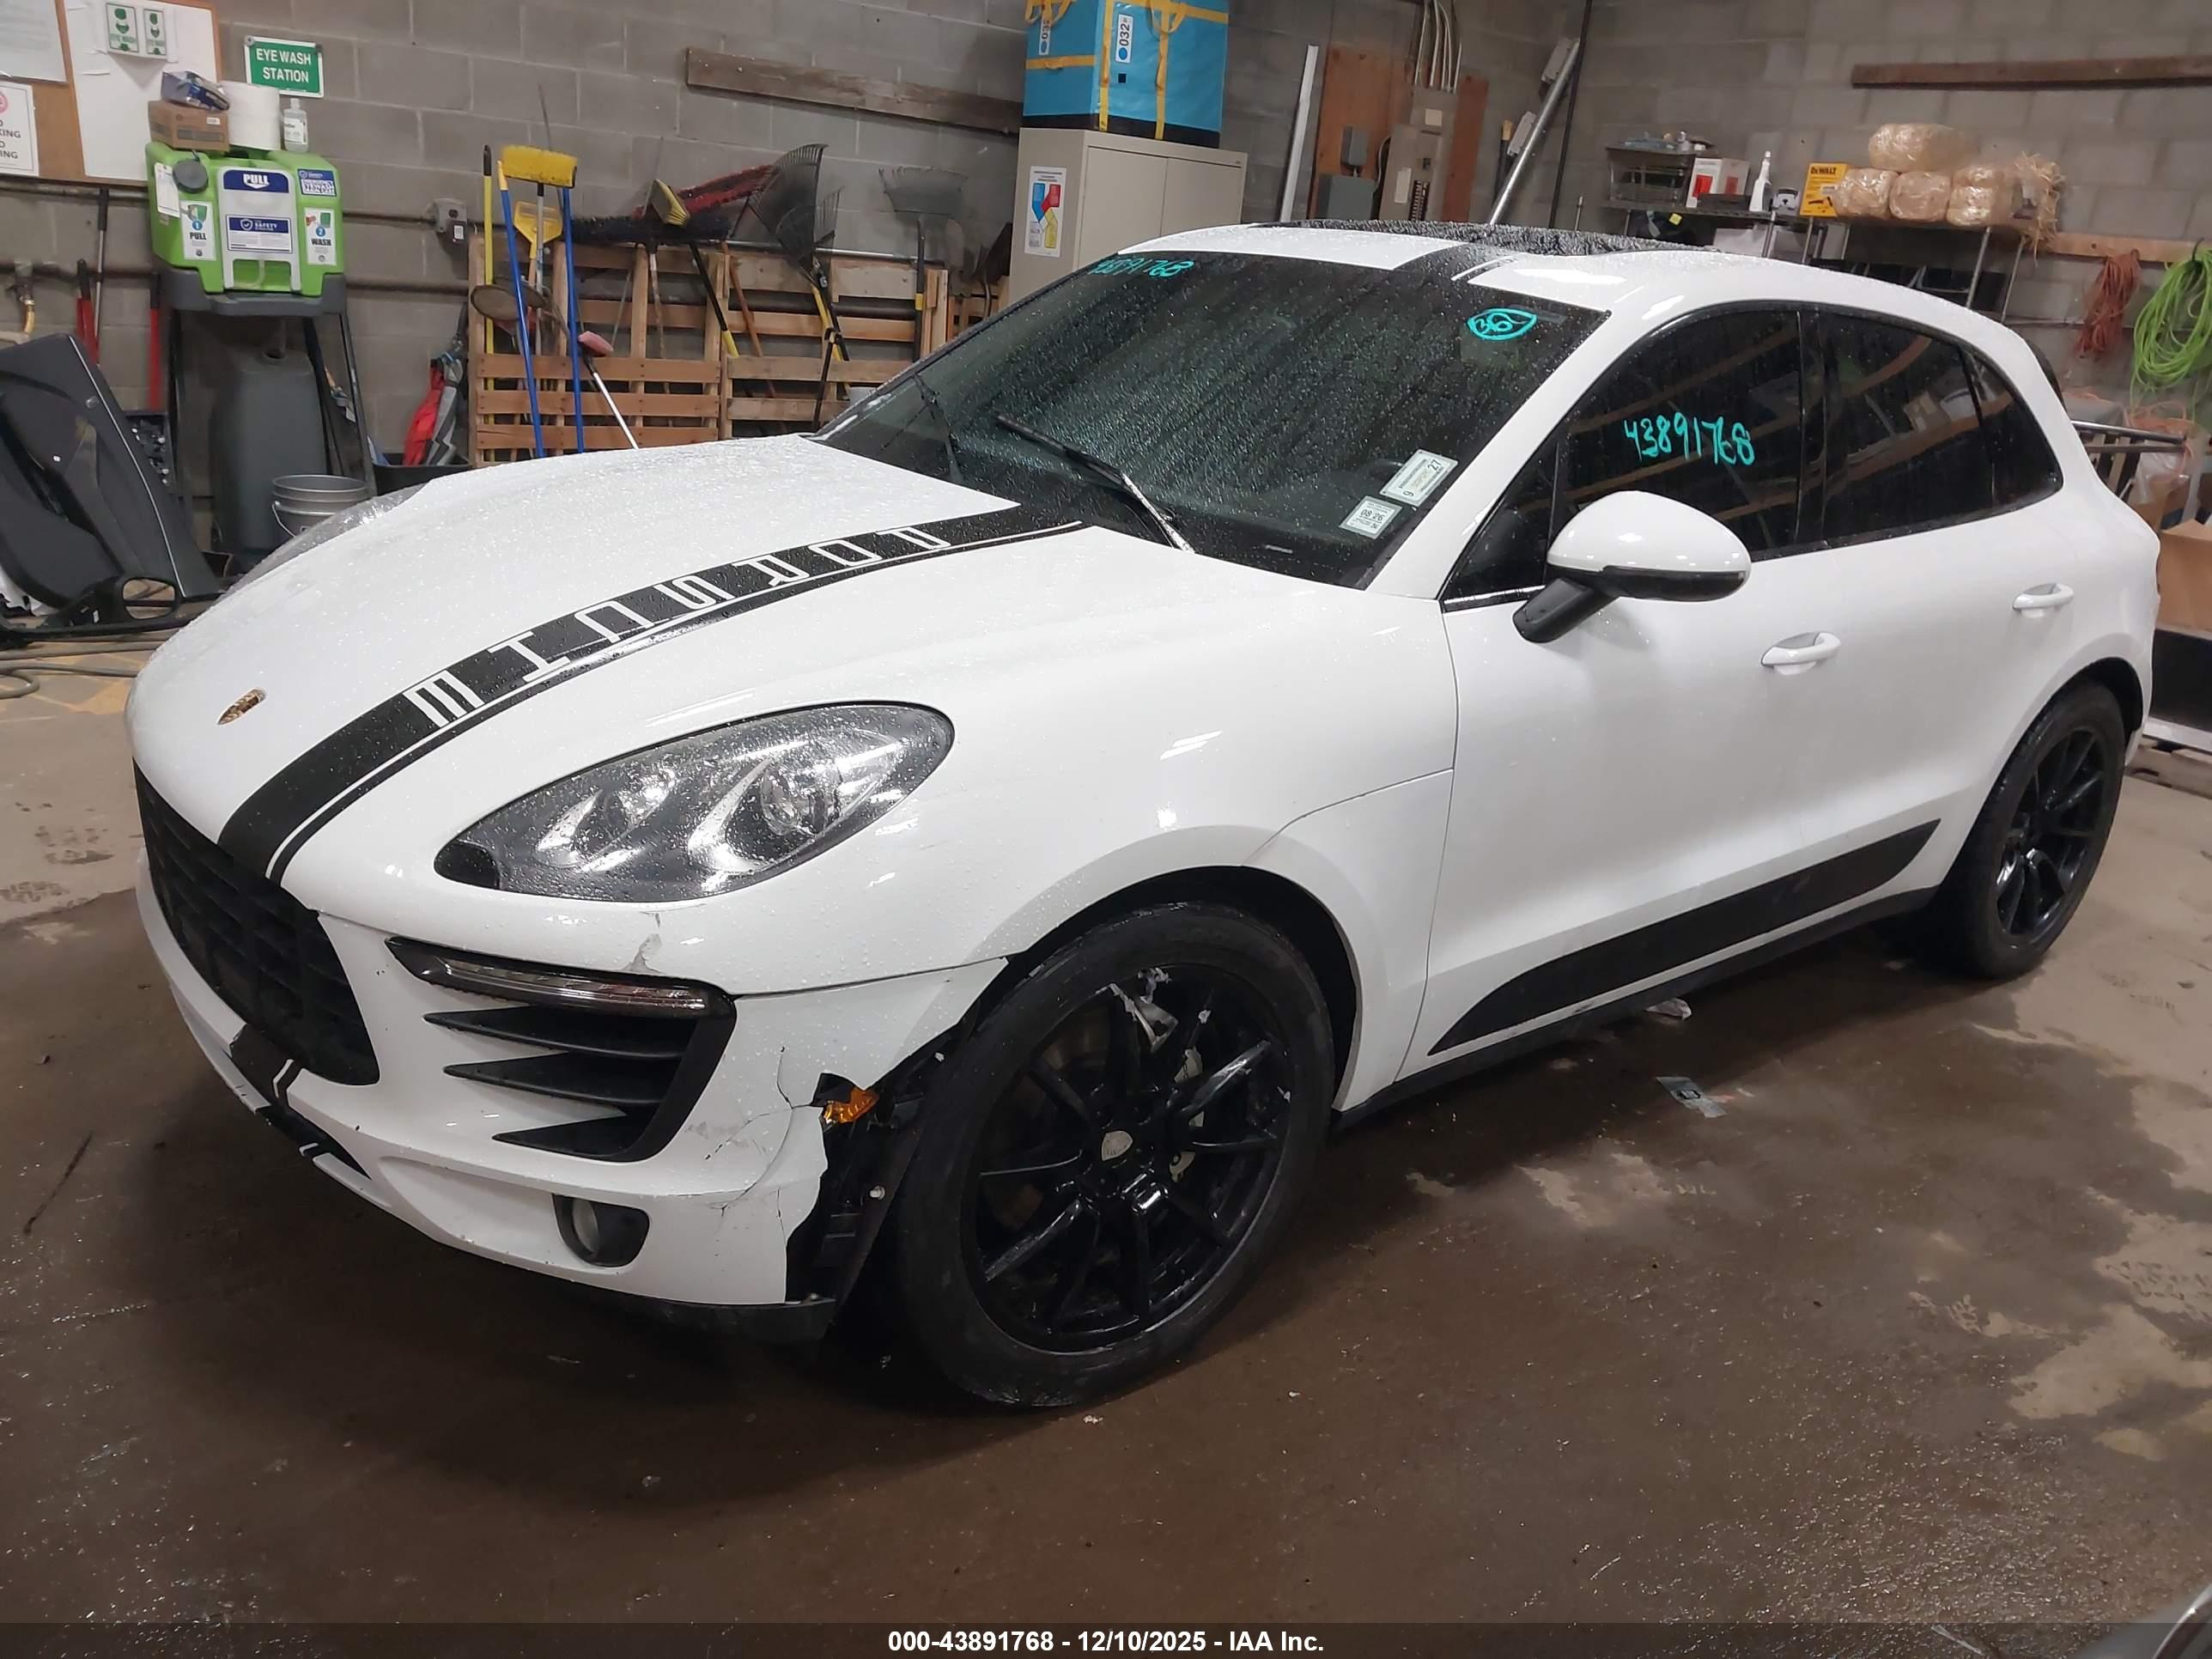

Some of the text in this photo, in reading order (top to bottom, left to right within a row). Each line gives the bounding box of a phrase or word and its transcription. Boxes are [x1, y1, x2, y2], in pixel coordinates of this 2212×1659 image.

[1119, 23, 1130, 46] 032
[256, 47, 312, 65] EYE WASH
[262, 66, 309, 83] STATION
[242, 173, 270, 185] PULL
[189, 231, 207, 240] PULL
[311, 238, 332, 246] WASH
[1623, 411, 1755, 466] 43891768
[1427, 459, 1443, 471] 27
